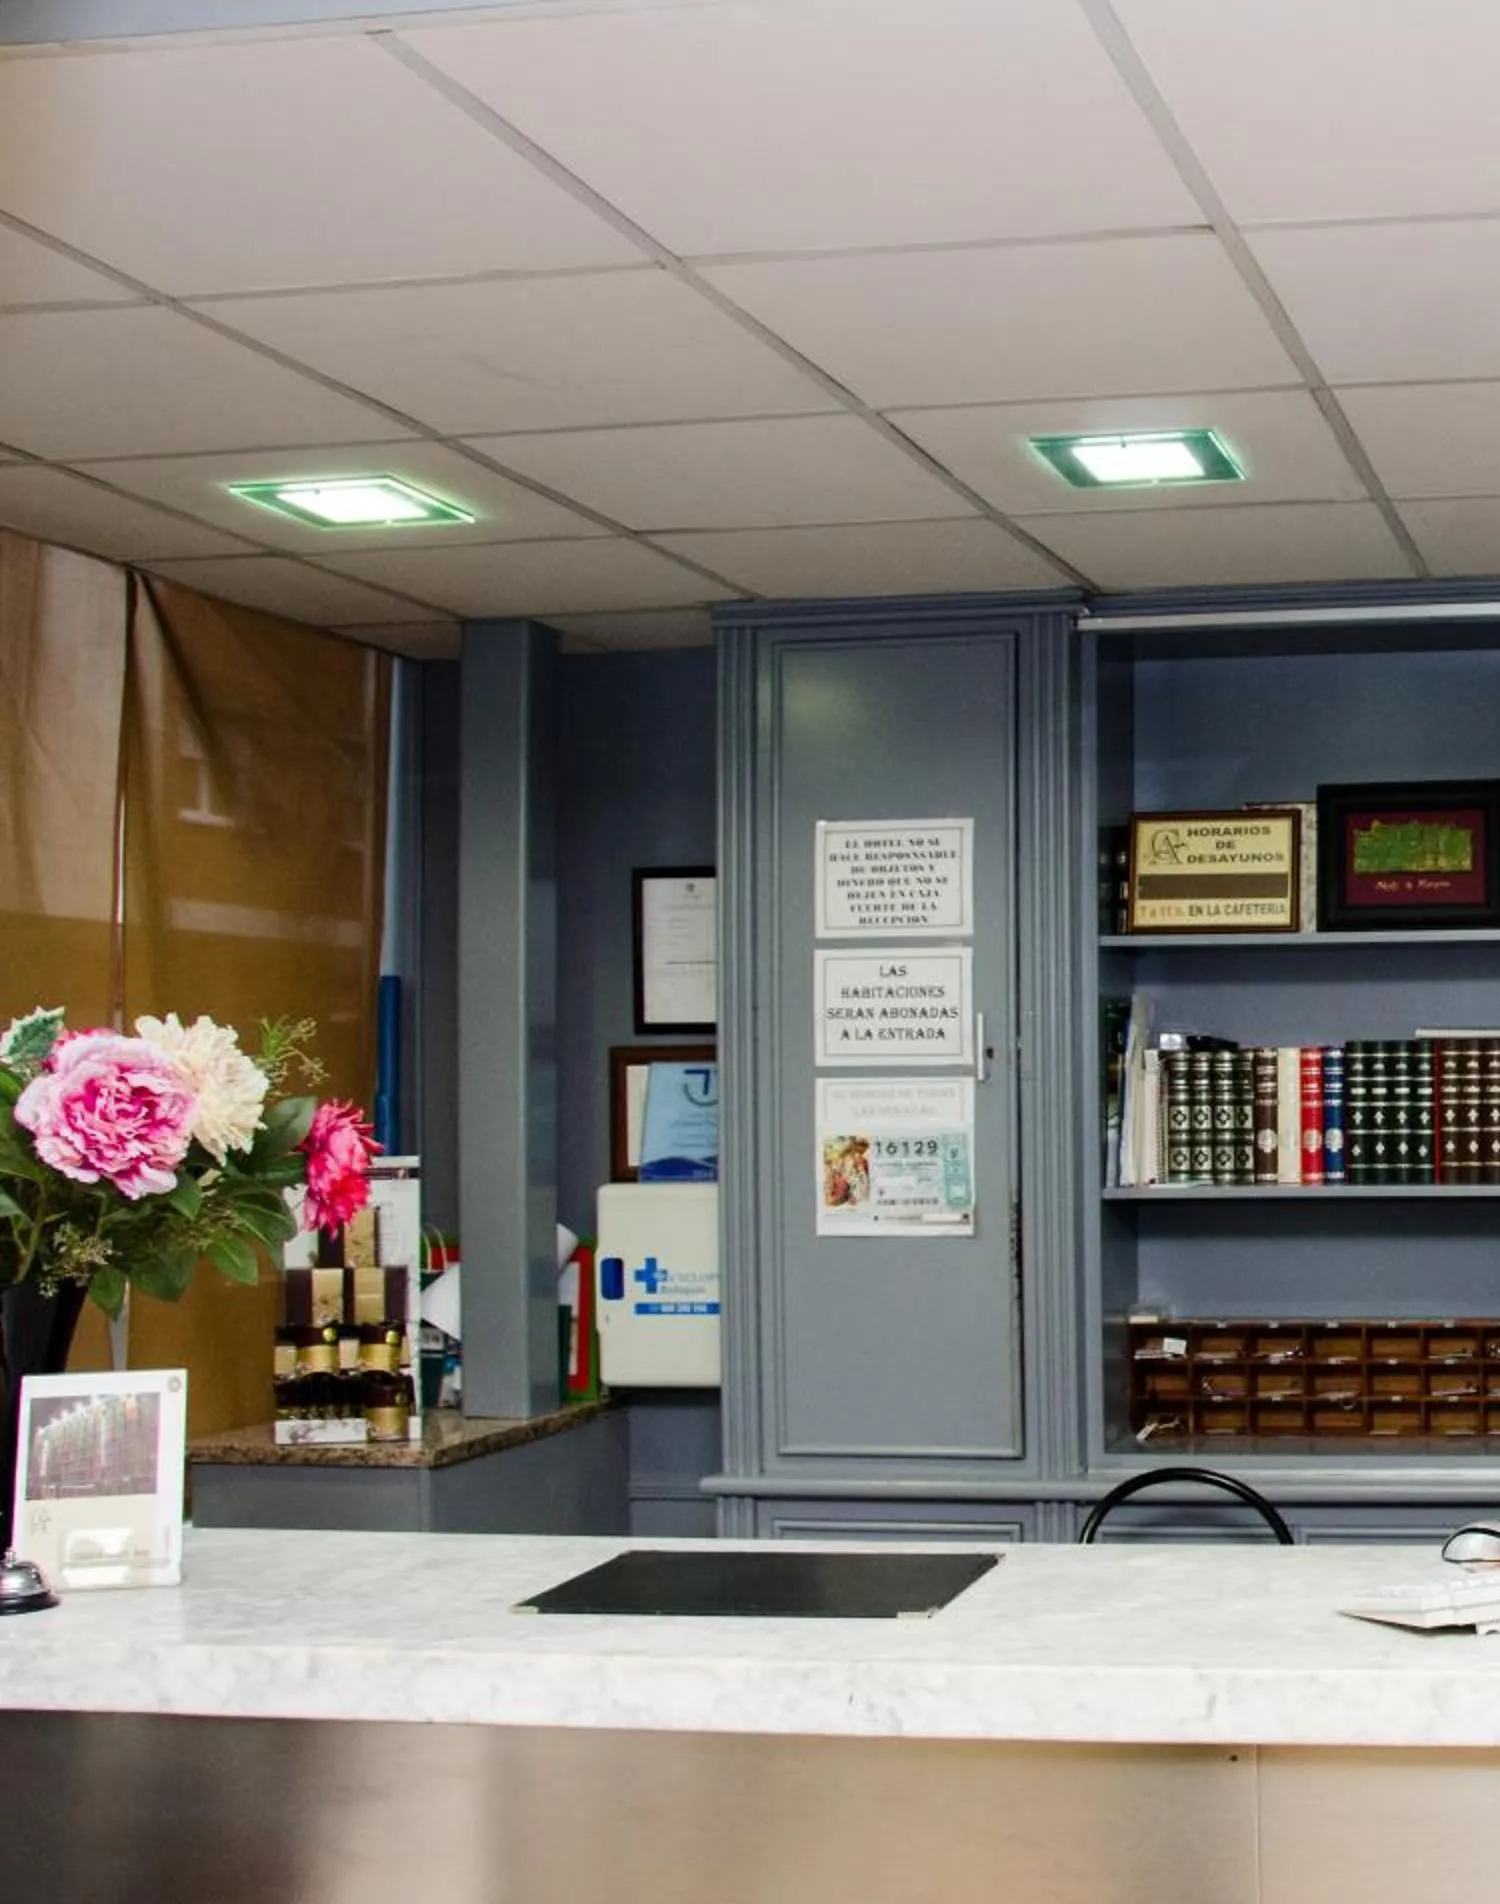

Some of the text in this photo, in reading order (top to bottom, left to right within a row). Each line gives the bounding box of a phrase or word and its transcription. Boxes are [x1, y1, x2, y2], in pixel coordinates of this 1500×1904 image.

[1187, 824, 1272, 837] HORARIOS
[845, 837, 941, 849] EL HOTEL NO SE
[1215, 840, 1237, 850] DE
[1187, 852, 1285, 864] DESAYUNOS
[916, 877, 932, 885] NO
[922, 901, 938, 910] LA
[1188, 904, 1204, 917] EN
[1207, 903, 1222, 916] LA
[879, 965, 908, 978] LAS
[840, 985, 946, 999] HABITACIONES
[826, 1006, 960, 1019] SERAN ABONADAS
[840, 1027, 946, 1041] A LA ENTRADA
[874, 1139, 938, 1156] 16129
